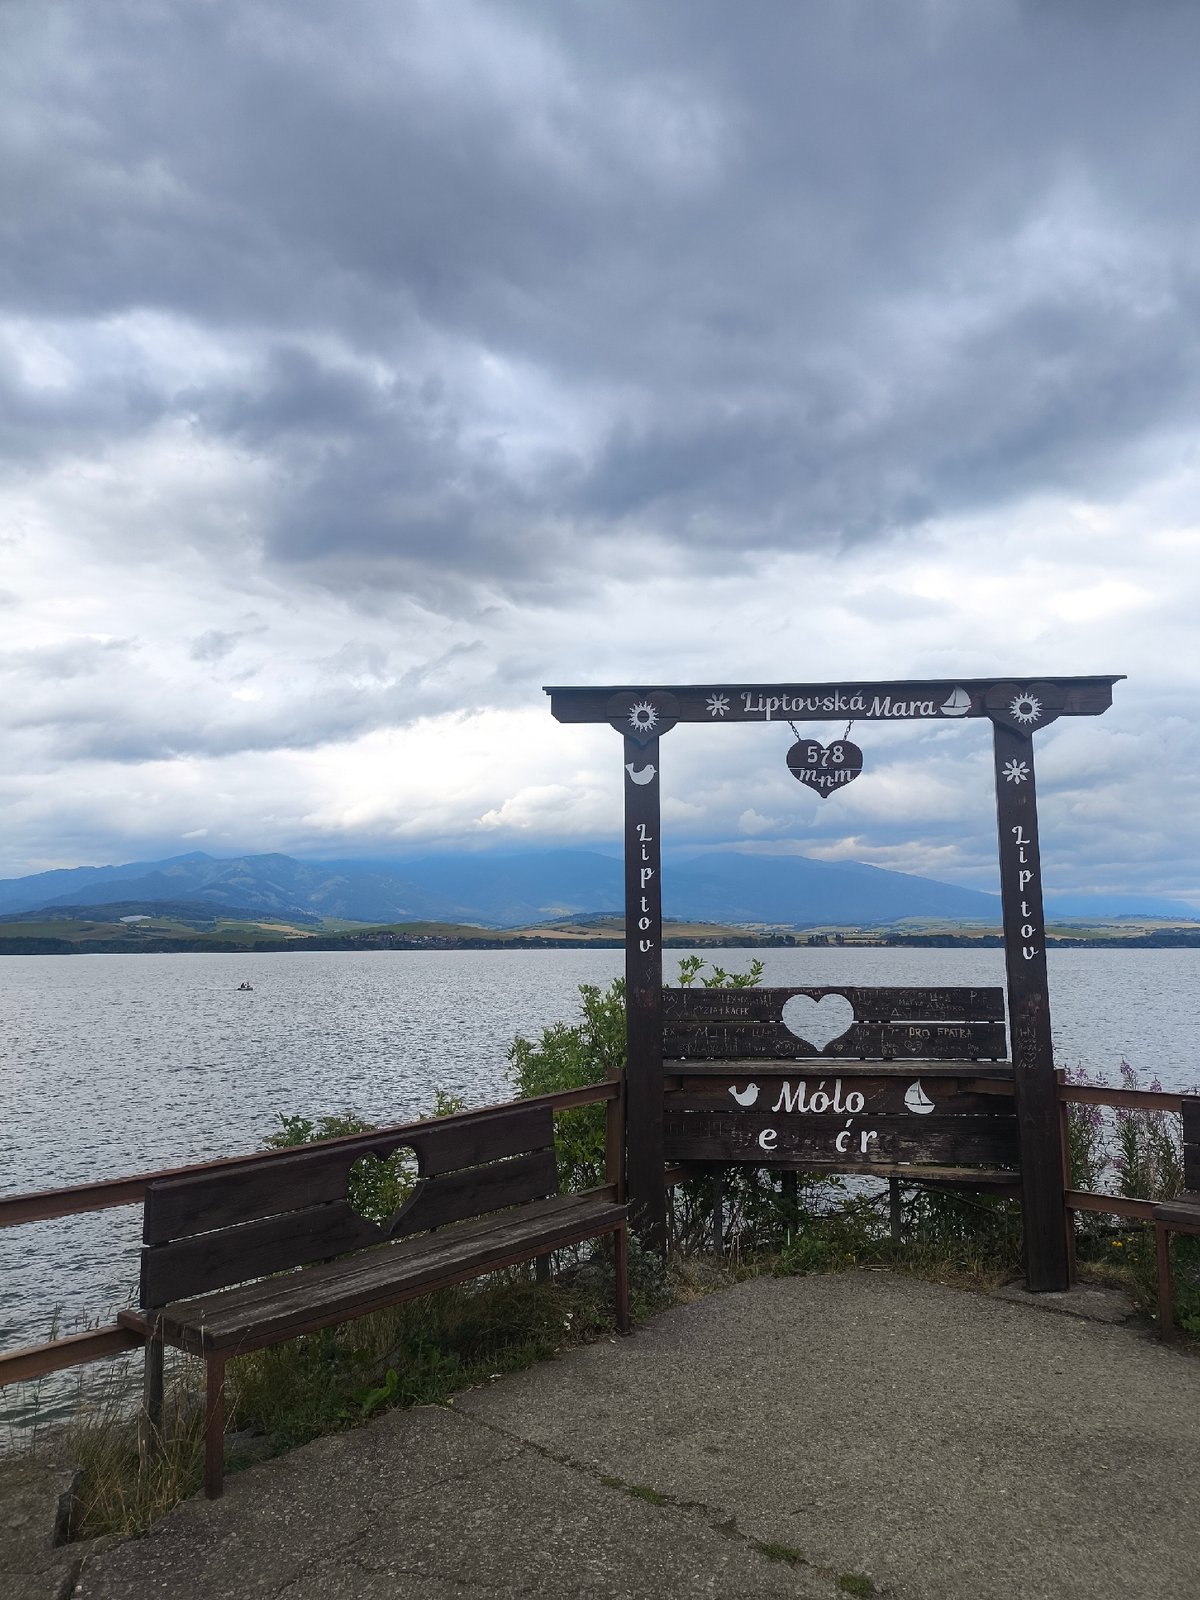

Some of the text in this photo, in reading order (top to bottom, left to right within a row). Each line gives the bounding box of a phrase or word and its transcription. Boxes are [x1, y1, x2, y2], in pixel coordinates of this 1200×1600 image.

[740, 689, 938, 721] Liptovská Mara
[807, 745, 845, 767] 578
[636, 823, 655, 953] Liptov
[1011, 825, 1039, 960] Liptov
[771, 1078, 865, 1113] Mólo
